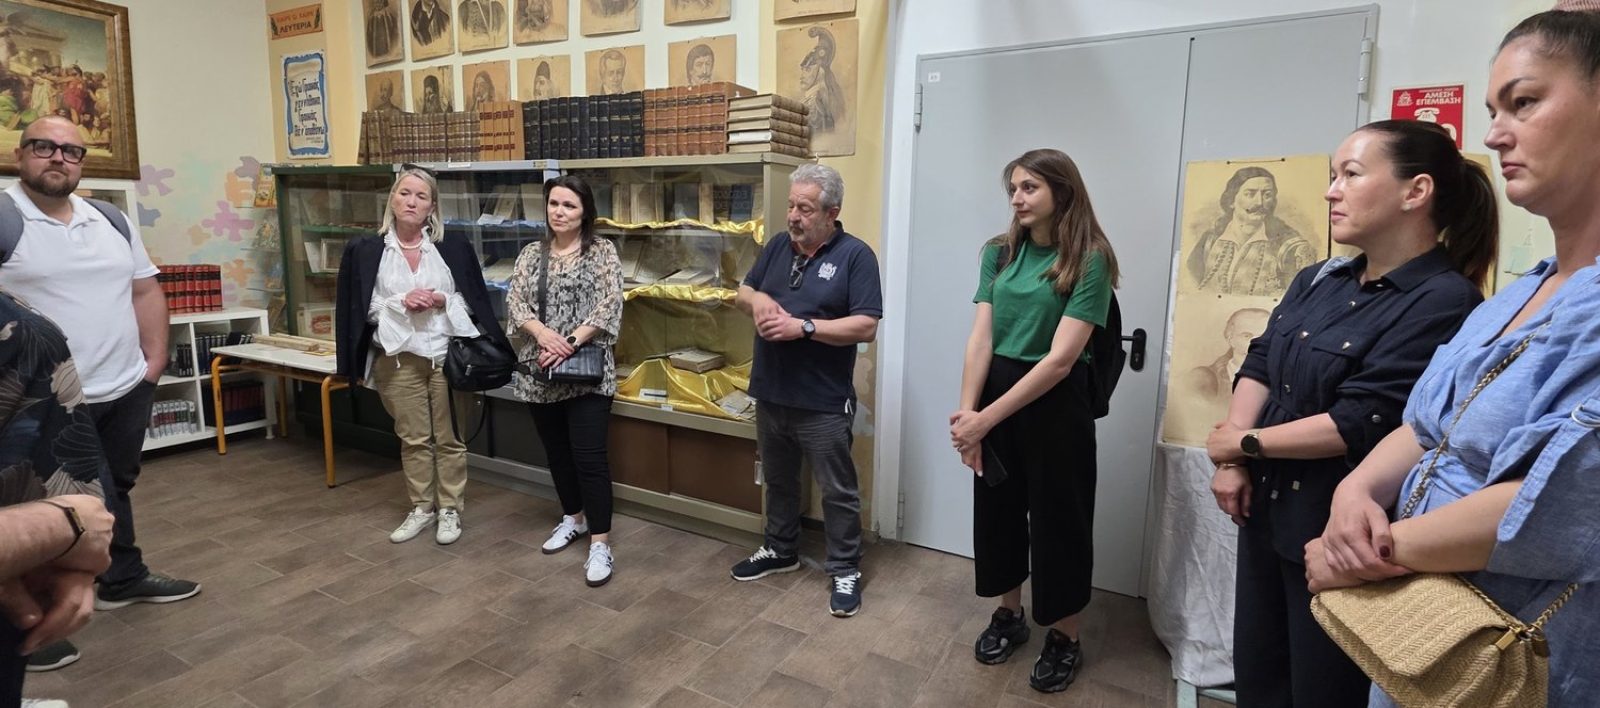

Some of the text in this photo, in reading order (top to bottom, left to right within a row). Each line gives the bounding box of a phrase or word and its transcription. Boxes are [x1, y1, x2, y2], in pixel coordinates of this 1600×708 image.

[279, 21, 312, 33] ΛΕΥΤΕΡΙΑ
[1424, 91, 1454, 99] ΑΜΕΣΗ
[1416, 97, 1461, 106] ΕΠΕΜΒΑΣΗ
